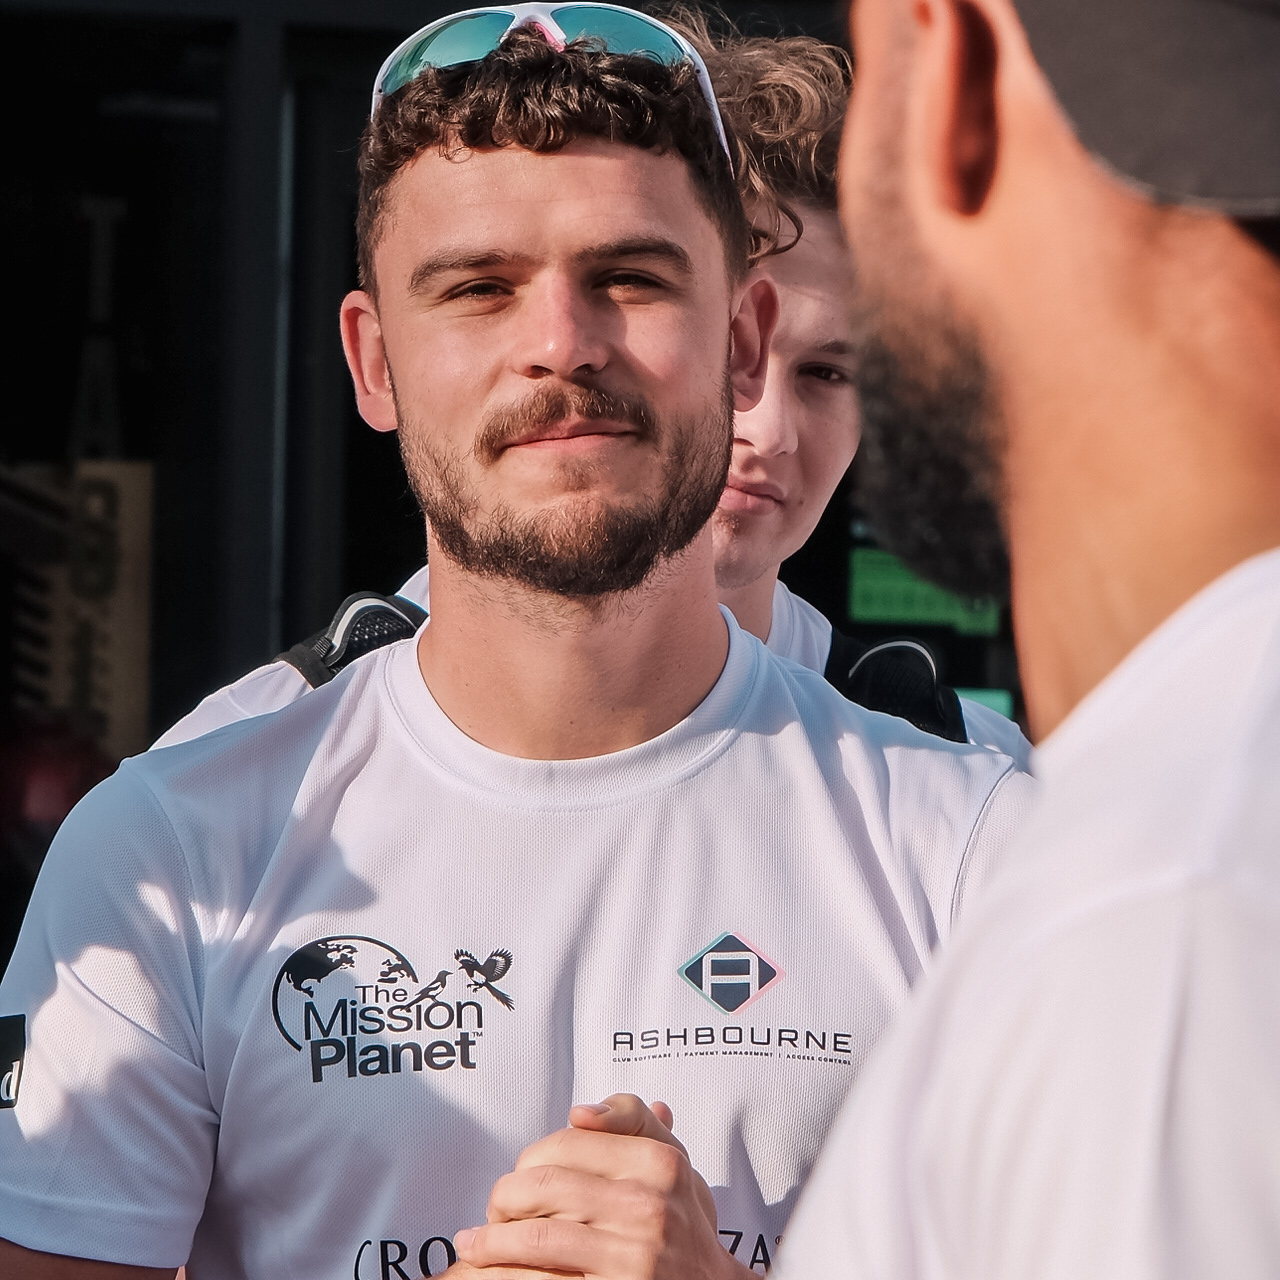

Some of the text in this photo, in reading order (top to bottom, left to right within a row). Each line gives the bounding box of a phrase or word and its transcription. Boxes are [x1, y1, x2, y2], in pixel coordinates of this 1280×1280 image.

[355, 985, 408, 1004] The
[304, 998, 483, 1040] Mission
[612, 1026, 853, 1054] ASHBOURNE
[634, 1053, 672, 1062] SOFTWARE
[817, 1056, 852, 1066] CONTROL
